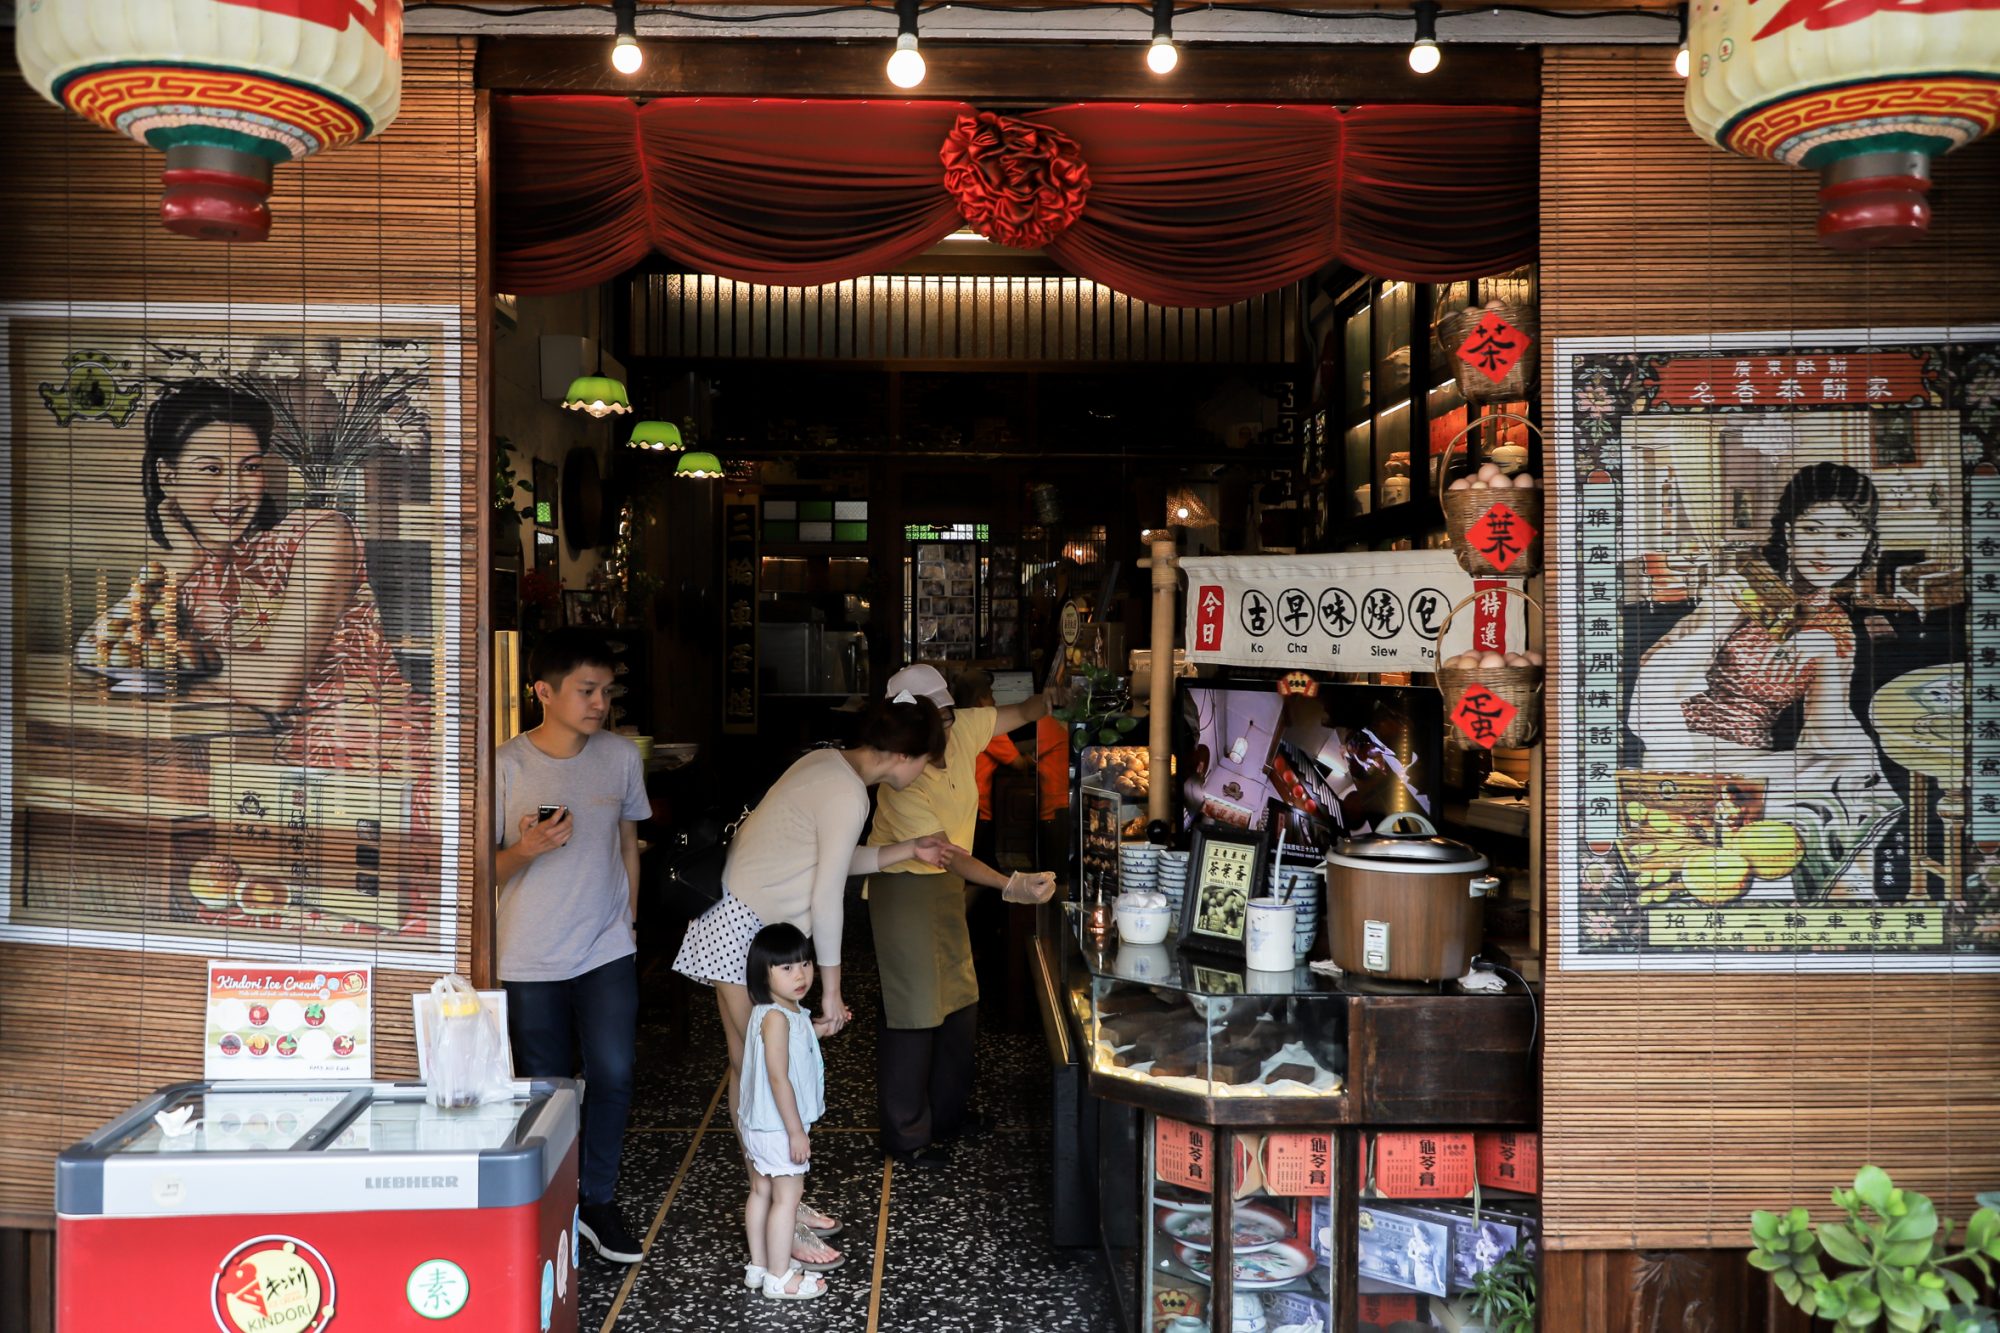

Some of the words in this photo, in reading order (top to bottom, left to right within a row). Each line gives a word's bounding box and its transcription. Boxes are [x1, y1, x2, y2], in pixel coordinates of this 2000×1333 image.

[1467, 324, 1516, 371] 茶
[1733, 357, 1848, 377] 廣東酥餅
[1689, 376, 1893, 404] 名香泰餅家
[1480, 511, 1521, 562] 葉
[1201, 591, 1223, 645] 今日
[1246, 590, 1443, 637] 古早味燒包
[1480, 592, 1503, 649] 特選
[1250, 642, 1264, 654] Ko
[1287, 642, 1308, 654] Cha
[1331, 643, 1341, 655] Bi
[1370, 645, 1398, 657] Siew
[1460, 692, 1503, 740] 蛋
[1207, 860, 1247, 882] 茶葉蛋
[216, 974, 262, 991] Kindori
[263, 976, 281, 990] Ice
[283, 976, 321, 991] Cream
[1188, 1131, 1204, 1179] 龜苓膏
[1309, 1137, 1327, 1185] 龜苓膏
[1418, 1138, 1437, 1187] 龜苓膏
[365, 1175, 459, 1189] LIEBHERR
[418, 1268, 457, 1310] 素
[248, 1302, 313, 1332] KINDORI
